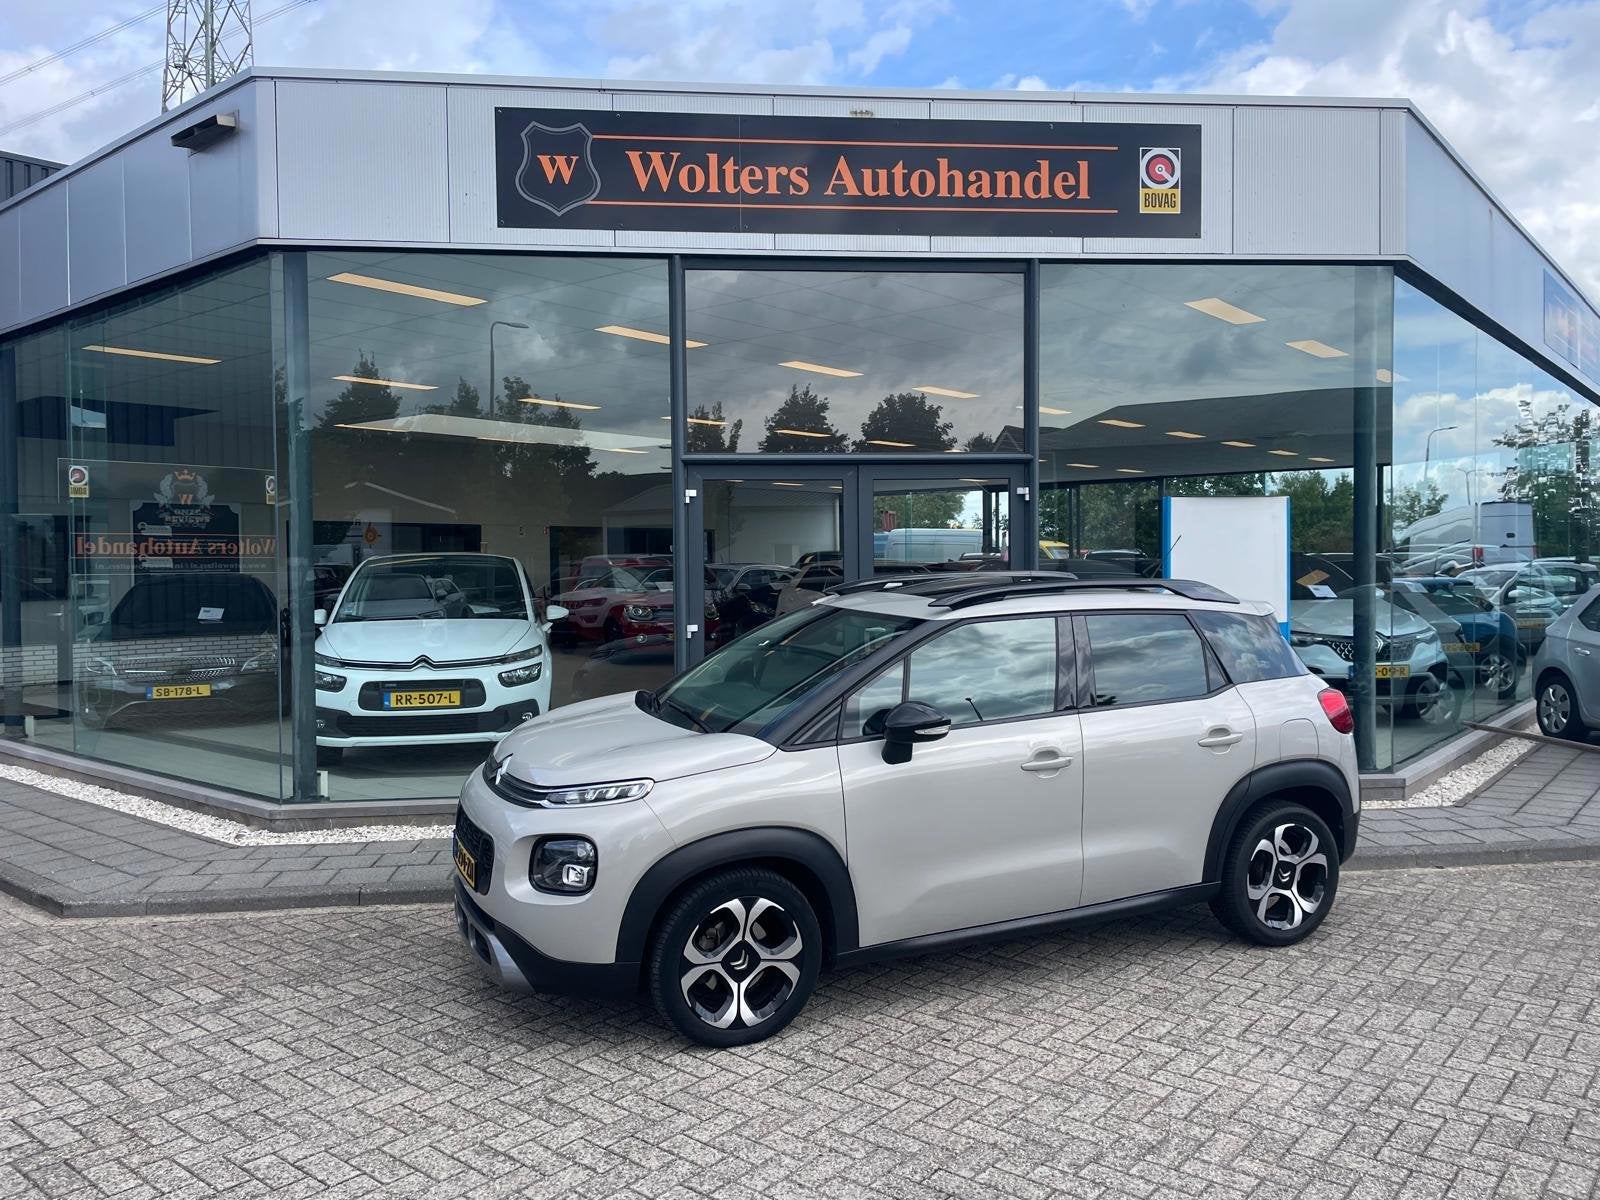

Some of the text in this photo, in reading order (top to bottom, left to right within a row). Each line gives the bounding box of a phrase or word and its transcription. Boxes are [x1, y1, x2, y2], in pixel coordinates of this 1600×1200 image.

[536, 155, 579, 184] W
[625, 151, 1091, 199] Wolters Autohandel
[1143, 192, 1176, 208] BOVAG
[156, 686, 203, 696] SB-178-L
[395, 693, 455, 705] RR-507-L
